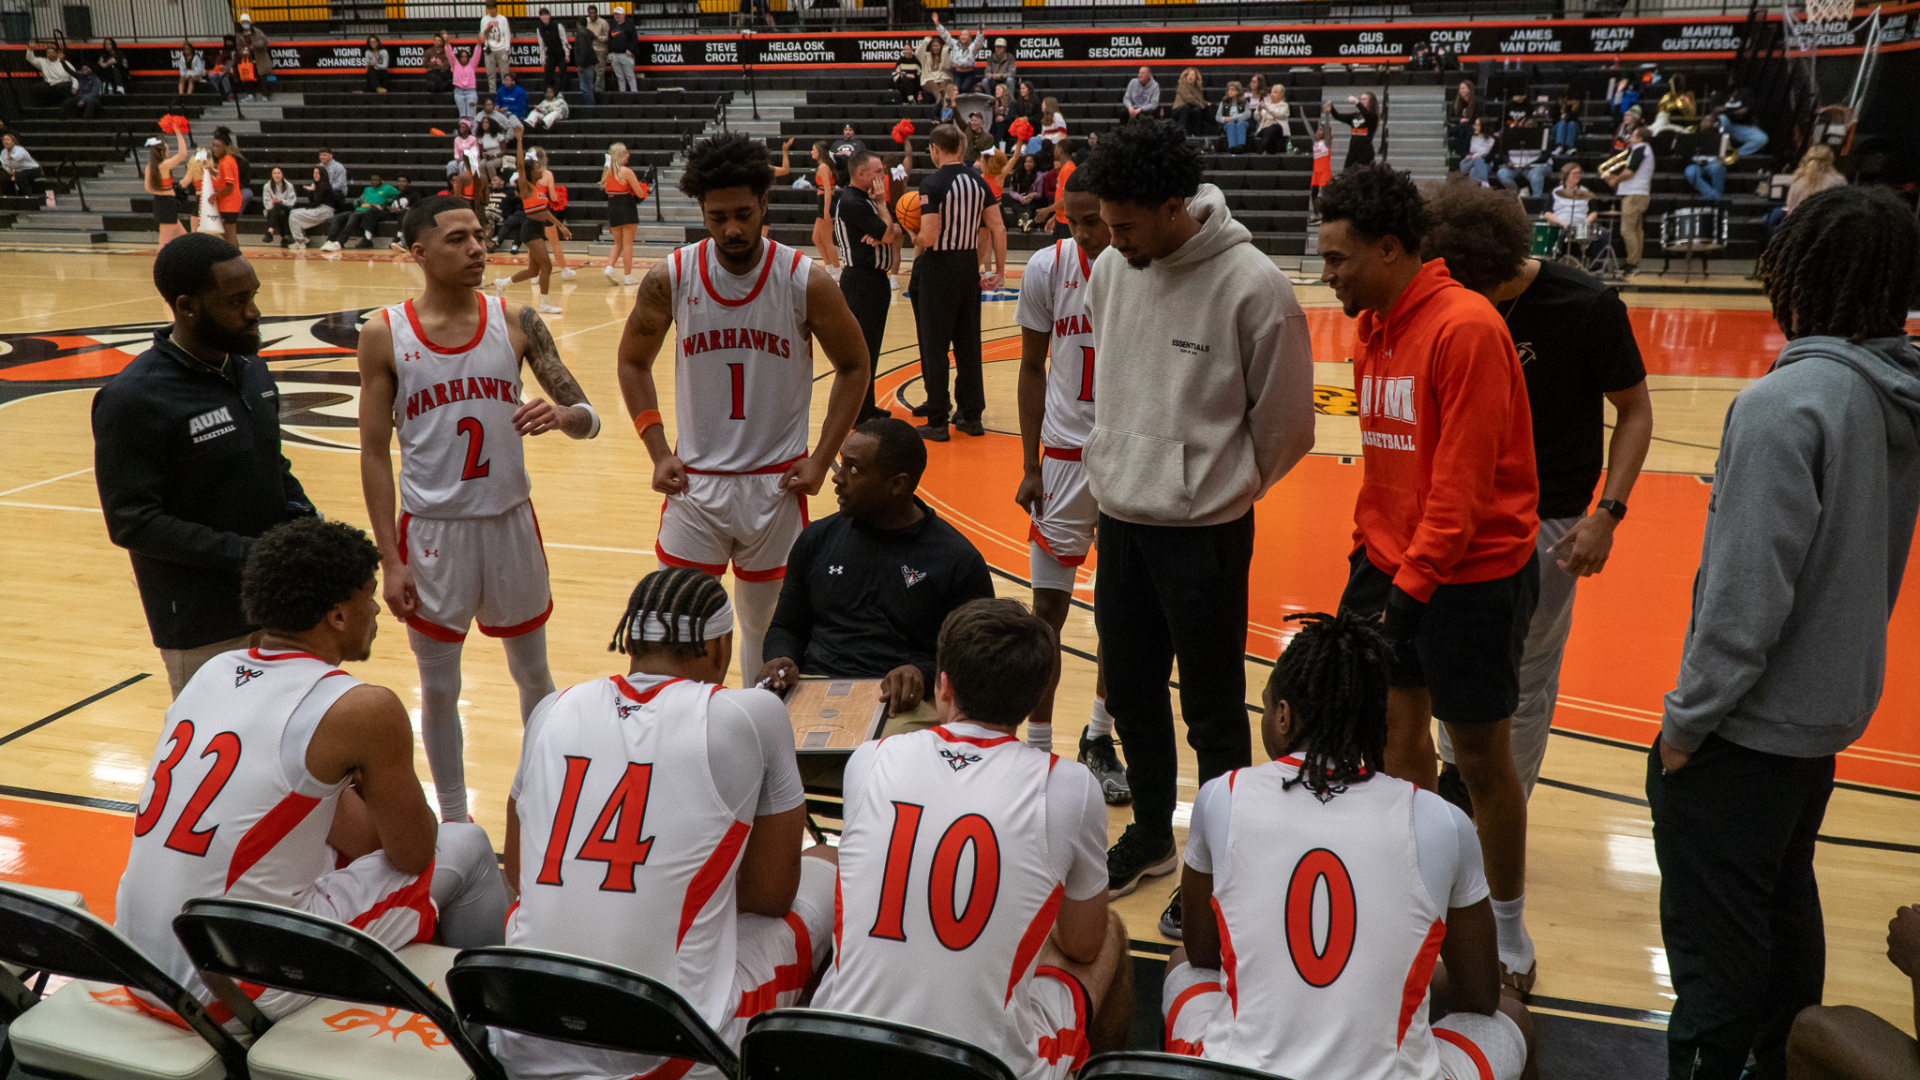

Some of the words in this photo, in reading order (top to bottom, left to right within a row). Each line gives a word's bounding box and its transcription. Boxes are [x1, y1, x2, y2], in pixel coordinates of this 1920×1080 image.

[1430, 30, 1471, 42] COLBY
[1510, 29, 1553, 41] JAMES
[1591, 27, 1635, 39] HEATH
[1681, 25, 1733, 37] MARTIN
[1020, 38, 1060, 48] CECILIA
[1111, 36, 1142, 47] DELIA
[1191, 35, 1230, 45] SCOTT
[1262, 34, 1306, 44] SASKIA
[1358, 32, 1383, 43] GUS
[653, 43, 681, 53] TAIAN
[706, 42, 737, 52] STEVE
[768, 41, 801, 51] HELGA
[803, 41, 825, 51] OSK
[1255, 45, 1312, 56] HERMANS
[1339, 43, 1402, 54] GARIBALDI
[1500, 42, 1525, 53] VAN
[1527, 41, 1562, 53] DYNE
[1593, 39, 1629, 51] ZAPF
[271, 49, 300, 58] DANIEL
[333, 48, 361, 57] VIGNIR
[400, 47, 424, 56] BRAD
[759, 51, 835, 62] HANNESDOTTIR
[1016, 48, 1064, 59] HINCAPIE
[1088, 47, 1166, 58] SESCIOREANU
[1195, 46, 1225, 56] ZEPP
[272, 58, 300, 67] PLASA
[397, 57, 425, 66] MOOD
[651, 53, 684, 63] SOUZA
[705, 53, 738, 63] CROTZ
[682, 328, 790, 359] WARHAWKS
[1172, 339, 1210, 353] ESSENTIALS
[1077, 345, 1095, 402] 1
[726, 363, 746, 420] 1
[190, 406, 233, 436] AUM
[193, 425, 236, 443] BASKETBALL
[456, 416, 490, 481] 2
[134, 719, 241, 857] 32
[536, 755, 655, 893] 14
[869, 800, 1000, 951] 10
[1284, 847, 1357, 988] 0
